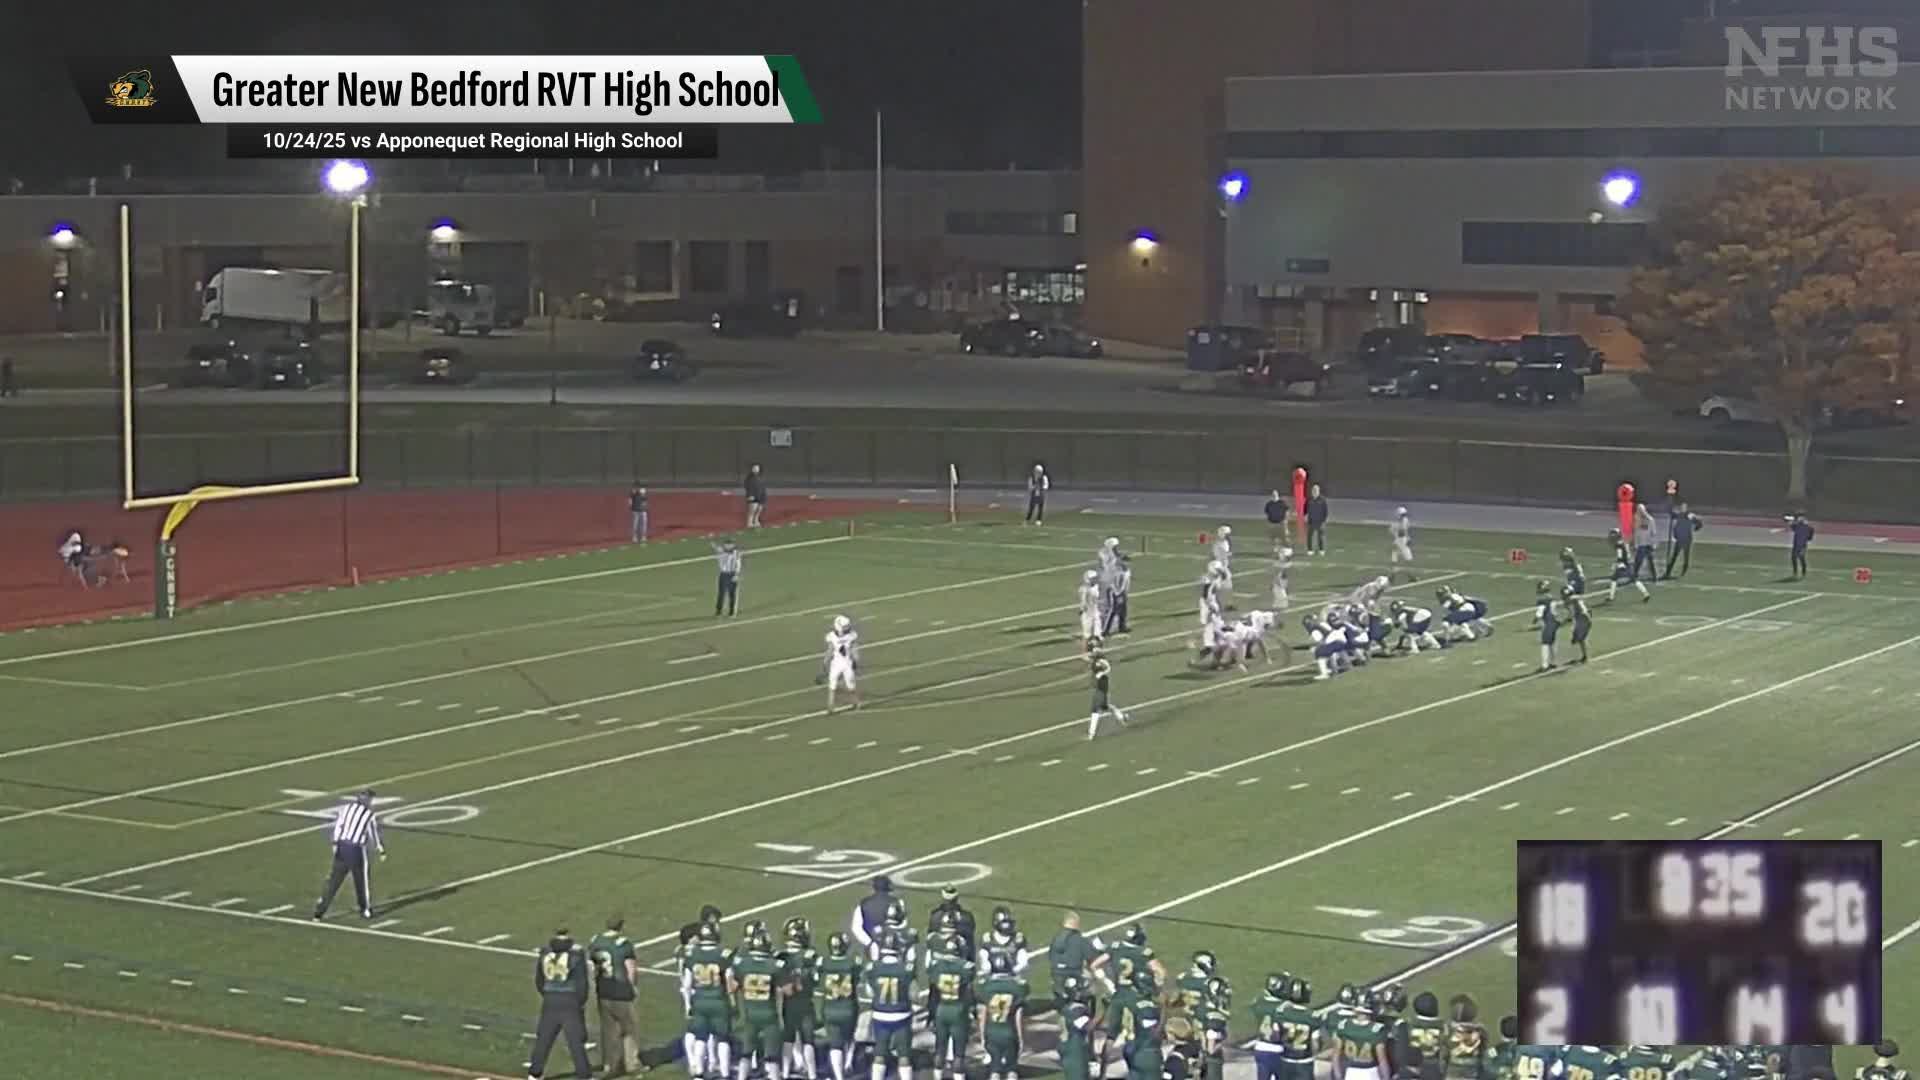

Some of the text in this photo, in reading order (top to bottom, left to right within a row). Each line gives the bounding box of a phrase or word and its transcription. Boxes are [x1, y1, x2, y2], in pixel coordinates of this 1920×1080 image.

[764, 849, 993, 888] 20
[1801, 881, 1867, 946] 20
[877, 976, 900, 1005] 71
[1534, 988, 1568, 1045] 2
[1736, 984, 1784, 1045] 14
[1822, 984, 1858, 1045] 4
